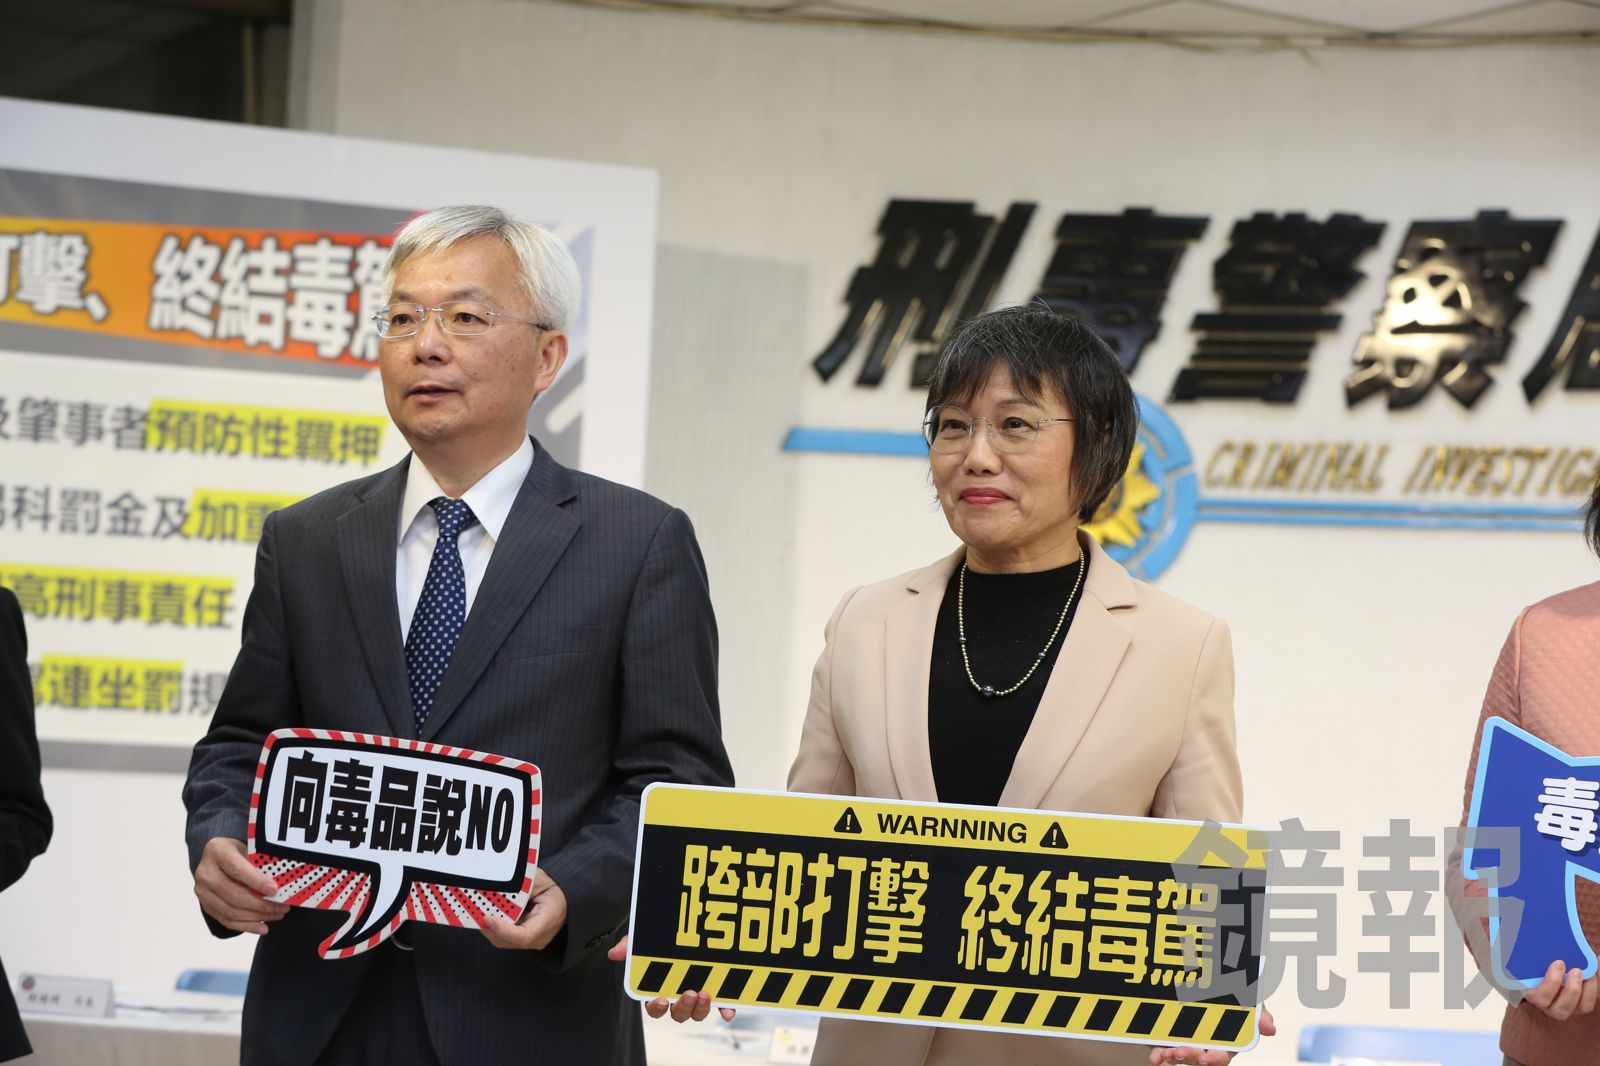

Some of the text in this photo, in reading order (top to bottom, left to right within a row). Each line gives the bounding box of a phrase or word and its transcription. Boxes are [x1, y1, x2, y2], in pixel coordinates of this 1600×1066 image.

[0, 397, 380, 465] 肇事者預防性羈押
[1204, 440, 1600, 497] CRIMINAL INVESTIG
[0, 484, 276, 543] 科罰金及加重
[877, 813, 1027, 843] WARNNING
[676, 844, 1219, 989] 跨部打擊 終結毒駕
